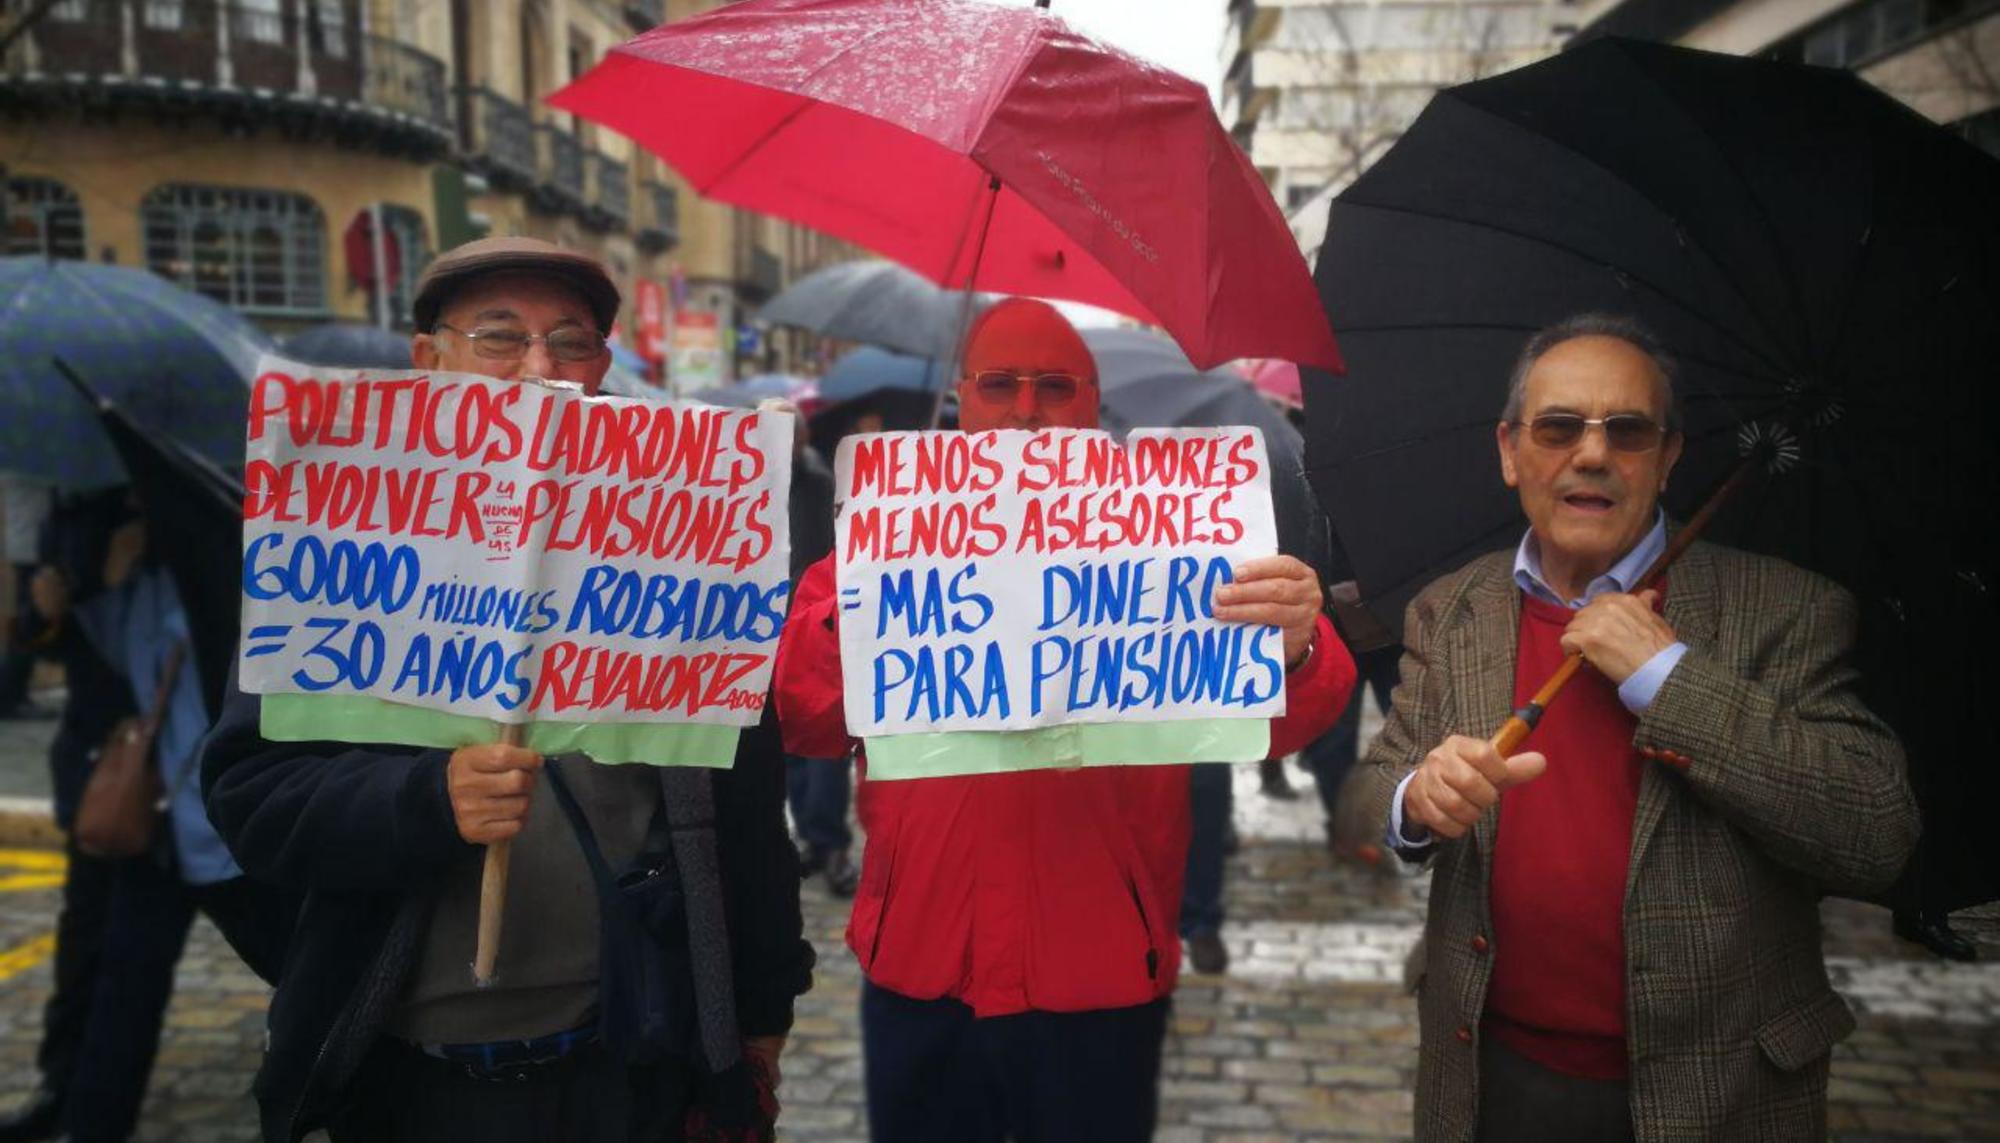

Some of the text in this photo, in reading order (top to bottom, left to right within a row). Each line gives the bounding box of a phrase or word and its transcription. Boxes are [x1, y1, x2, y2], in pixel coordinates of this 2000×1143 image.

[527, 395, 765, 497] LADRONES
[851, 431, 1259, 498] MENOS SENADORES
[243, 459, 491, 544] DEVOLVER
[495, 479, 515, 499] LA
[847, 489, 1244, 564] MENOS ASESORES
[419, 574, 560, 633] MILLONES
[565, 564, 790, 643] ROBADOS
[876, 562, 994, 639] MAS
[246, 625, 293, 657] =
[292, 617, 385, 691] 30
[392, 631, 534, 711] AÑOS
[873, 640, 1010, 723] PARA
